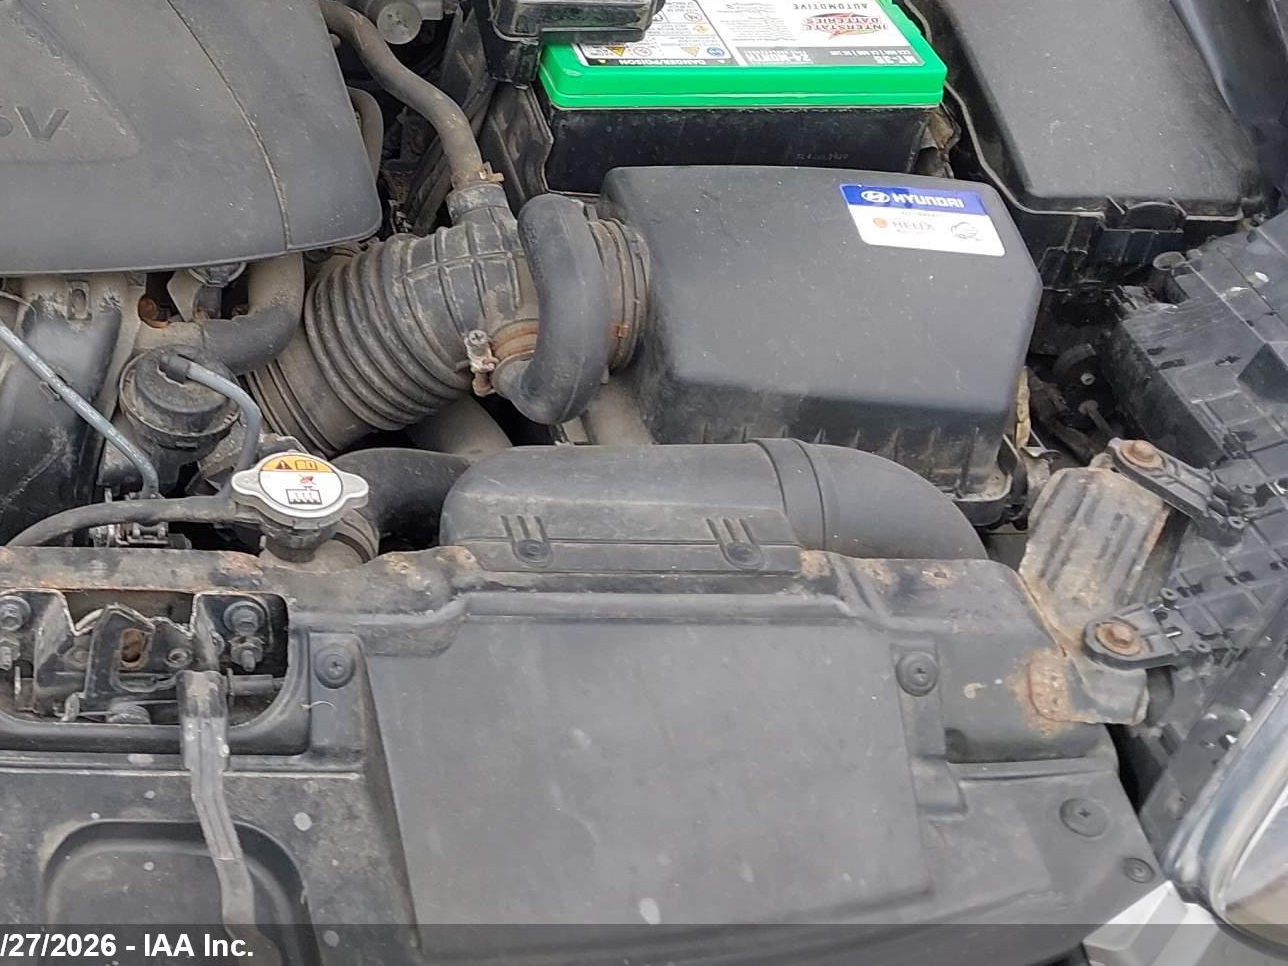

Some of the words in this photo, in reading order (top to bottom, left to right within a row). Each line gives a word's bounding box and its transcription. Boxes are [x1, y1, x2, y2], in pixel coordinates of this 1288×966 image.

[792, 3, 868, 11] AUTOMOTIVE
[805, 24, 887, 32] INTERSTATE
[892, 193, 965, 209] HYUNDAI
